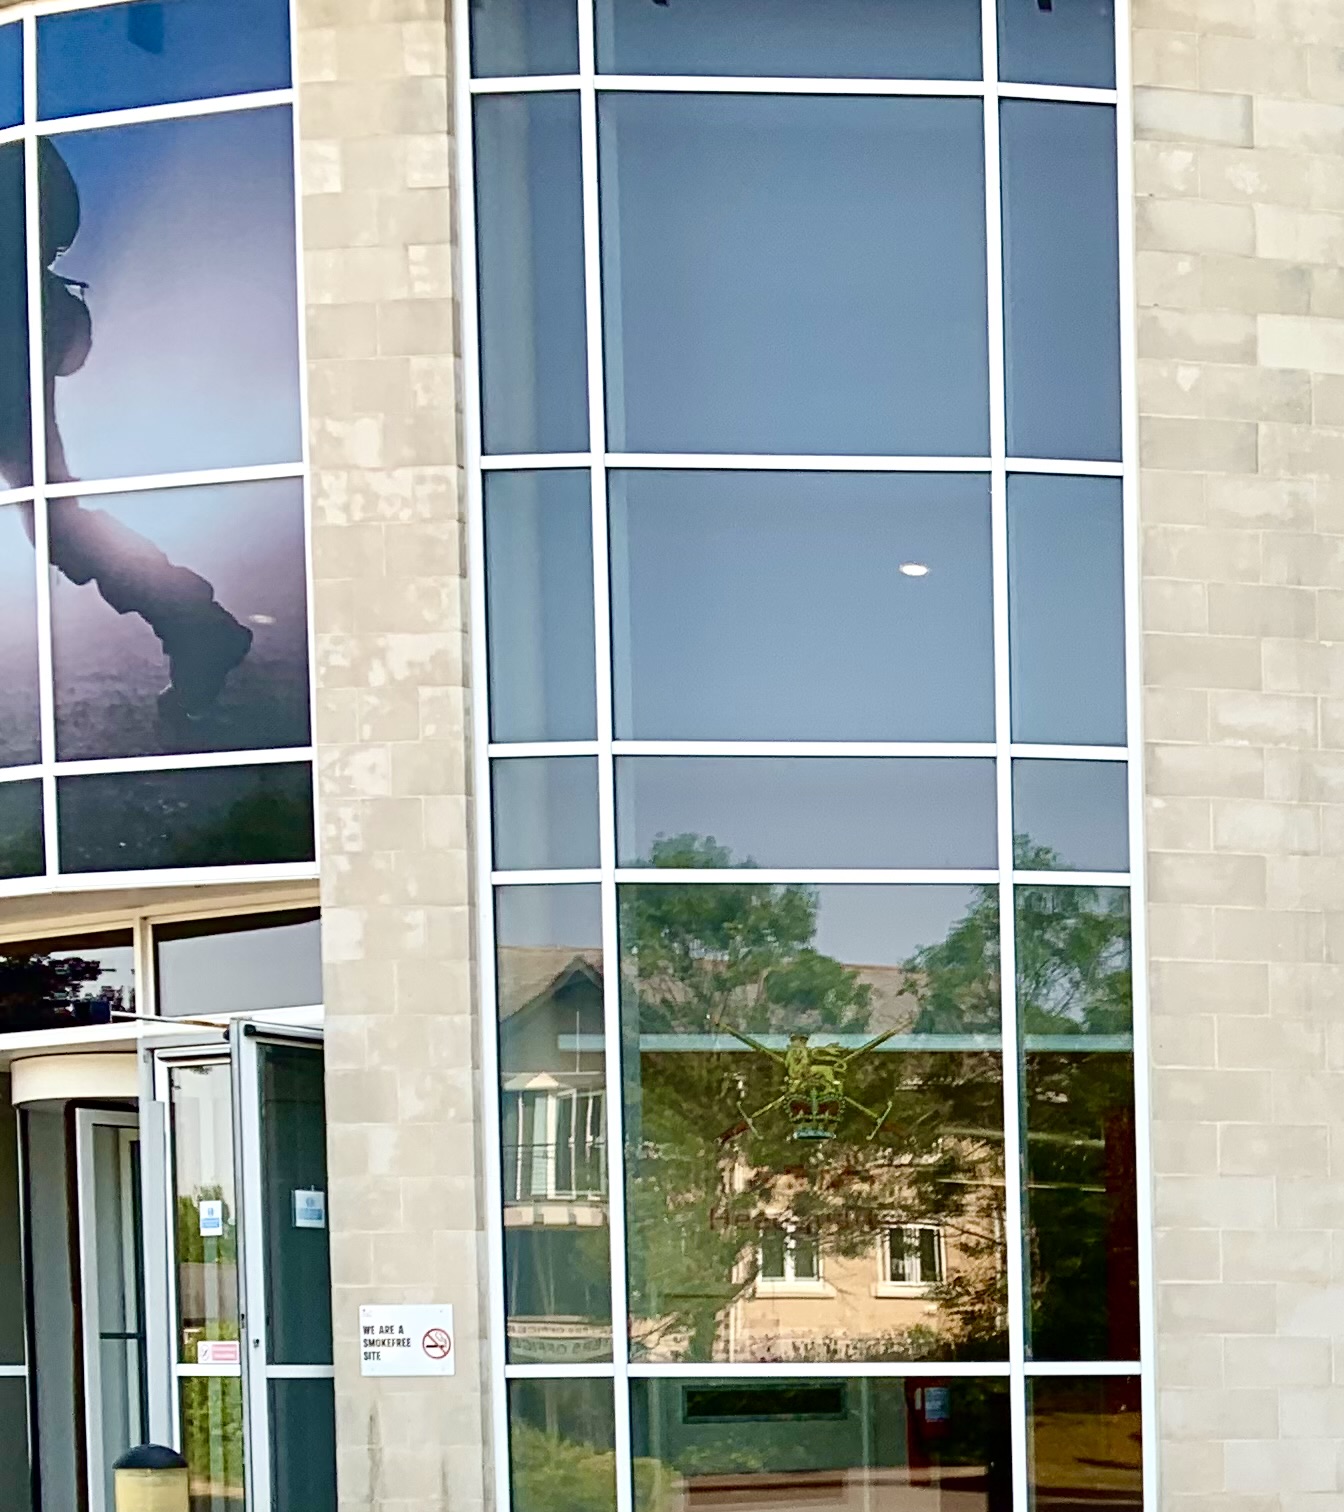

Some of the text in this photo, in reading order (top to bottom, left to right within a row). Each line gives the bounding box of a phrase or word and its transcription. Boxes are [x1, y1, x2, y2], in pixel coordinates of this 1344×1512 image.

[363, 1325, 404, 1335] WE ARE A
[363, 1338, 411, 1348] SMOKEFREE
[363, 1351, 381, 1360] SITE
